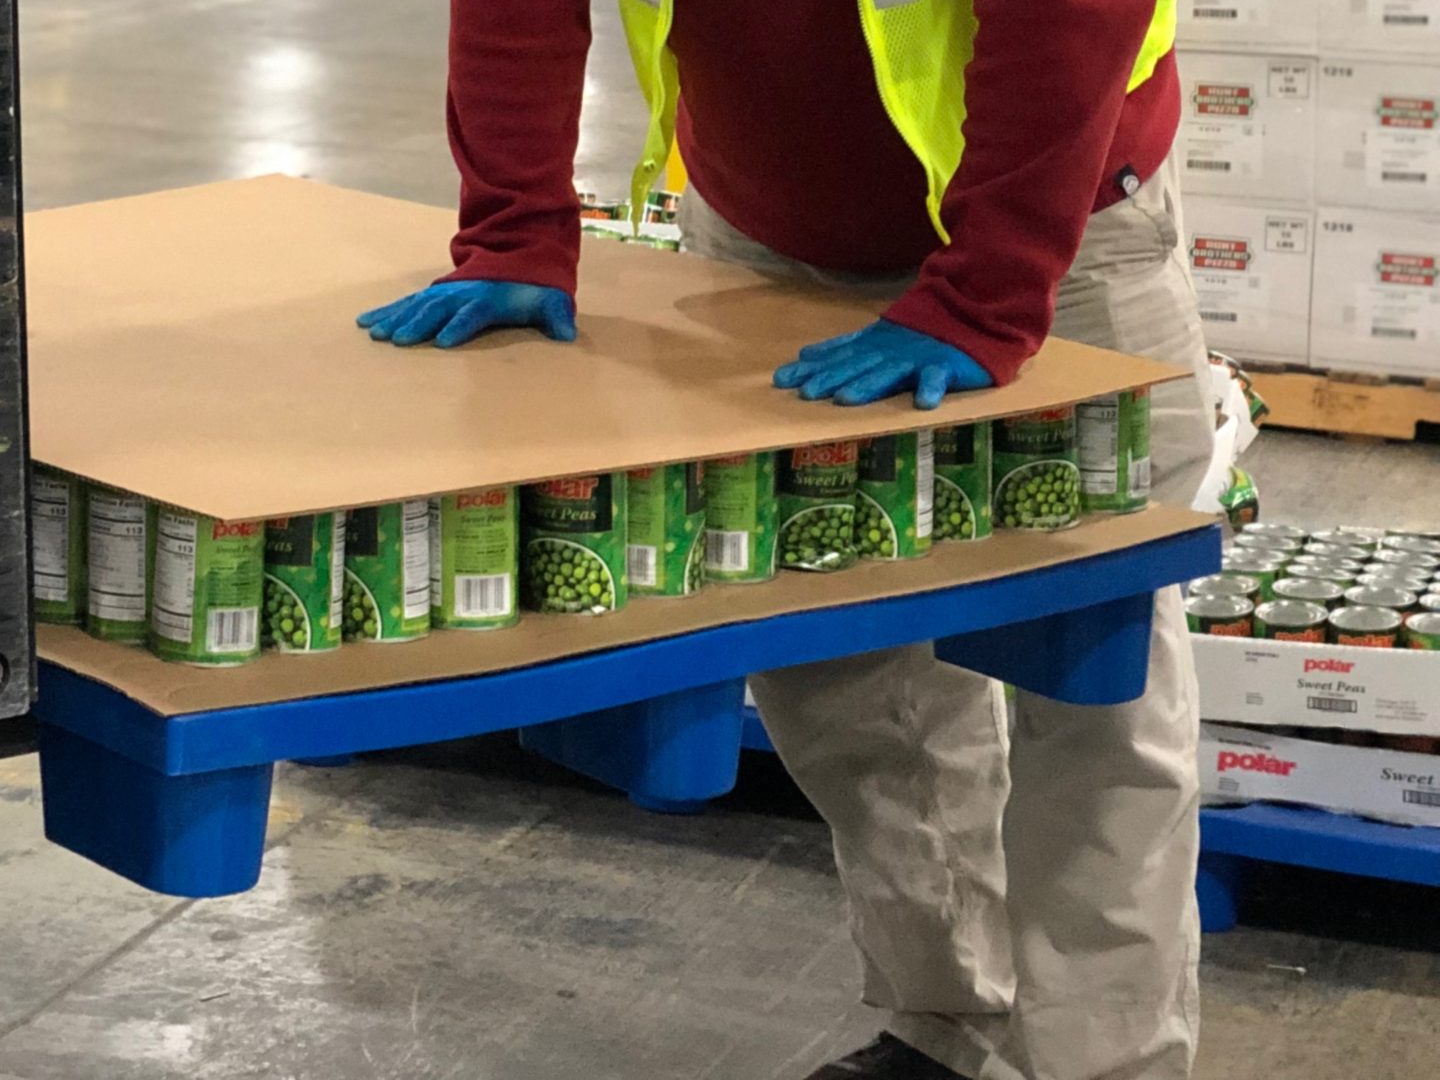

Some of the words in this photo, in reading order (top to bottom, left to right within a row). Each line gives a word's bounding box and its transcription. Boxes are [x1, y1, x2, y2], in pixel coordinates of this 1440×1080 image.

[793, 471, 837, 487] Sweet
[561, 506, 597, 520] Peas
[177, 544, 194, 554] 113
[1303, 657, 1356, 673] polar
[1296, 677, 1333, 691] Sweet
[1335, 680, 1366, 694] Peas
[1217, 750, 1297, 777] polar
[1380, 767, 1435, 786] Sweet
